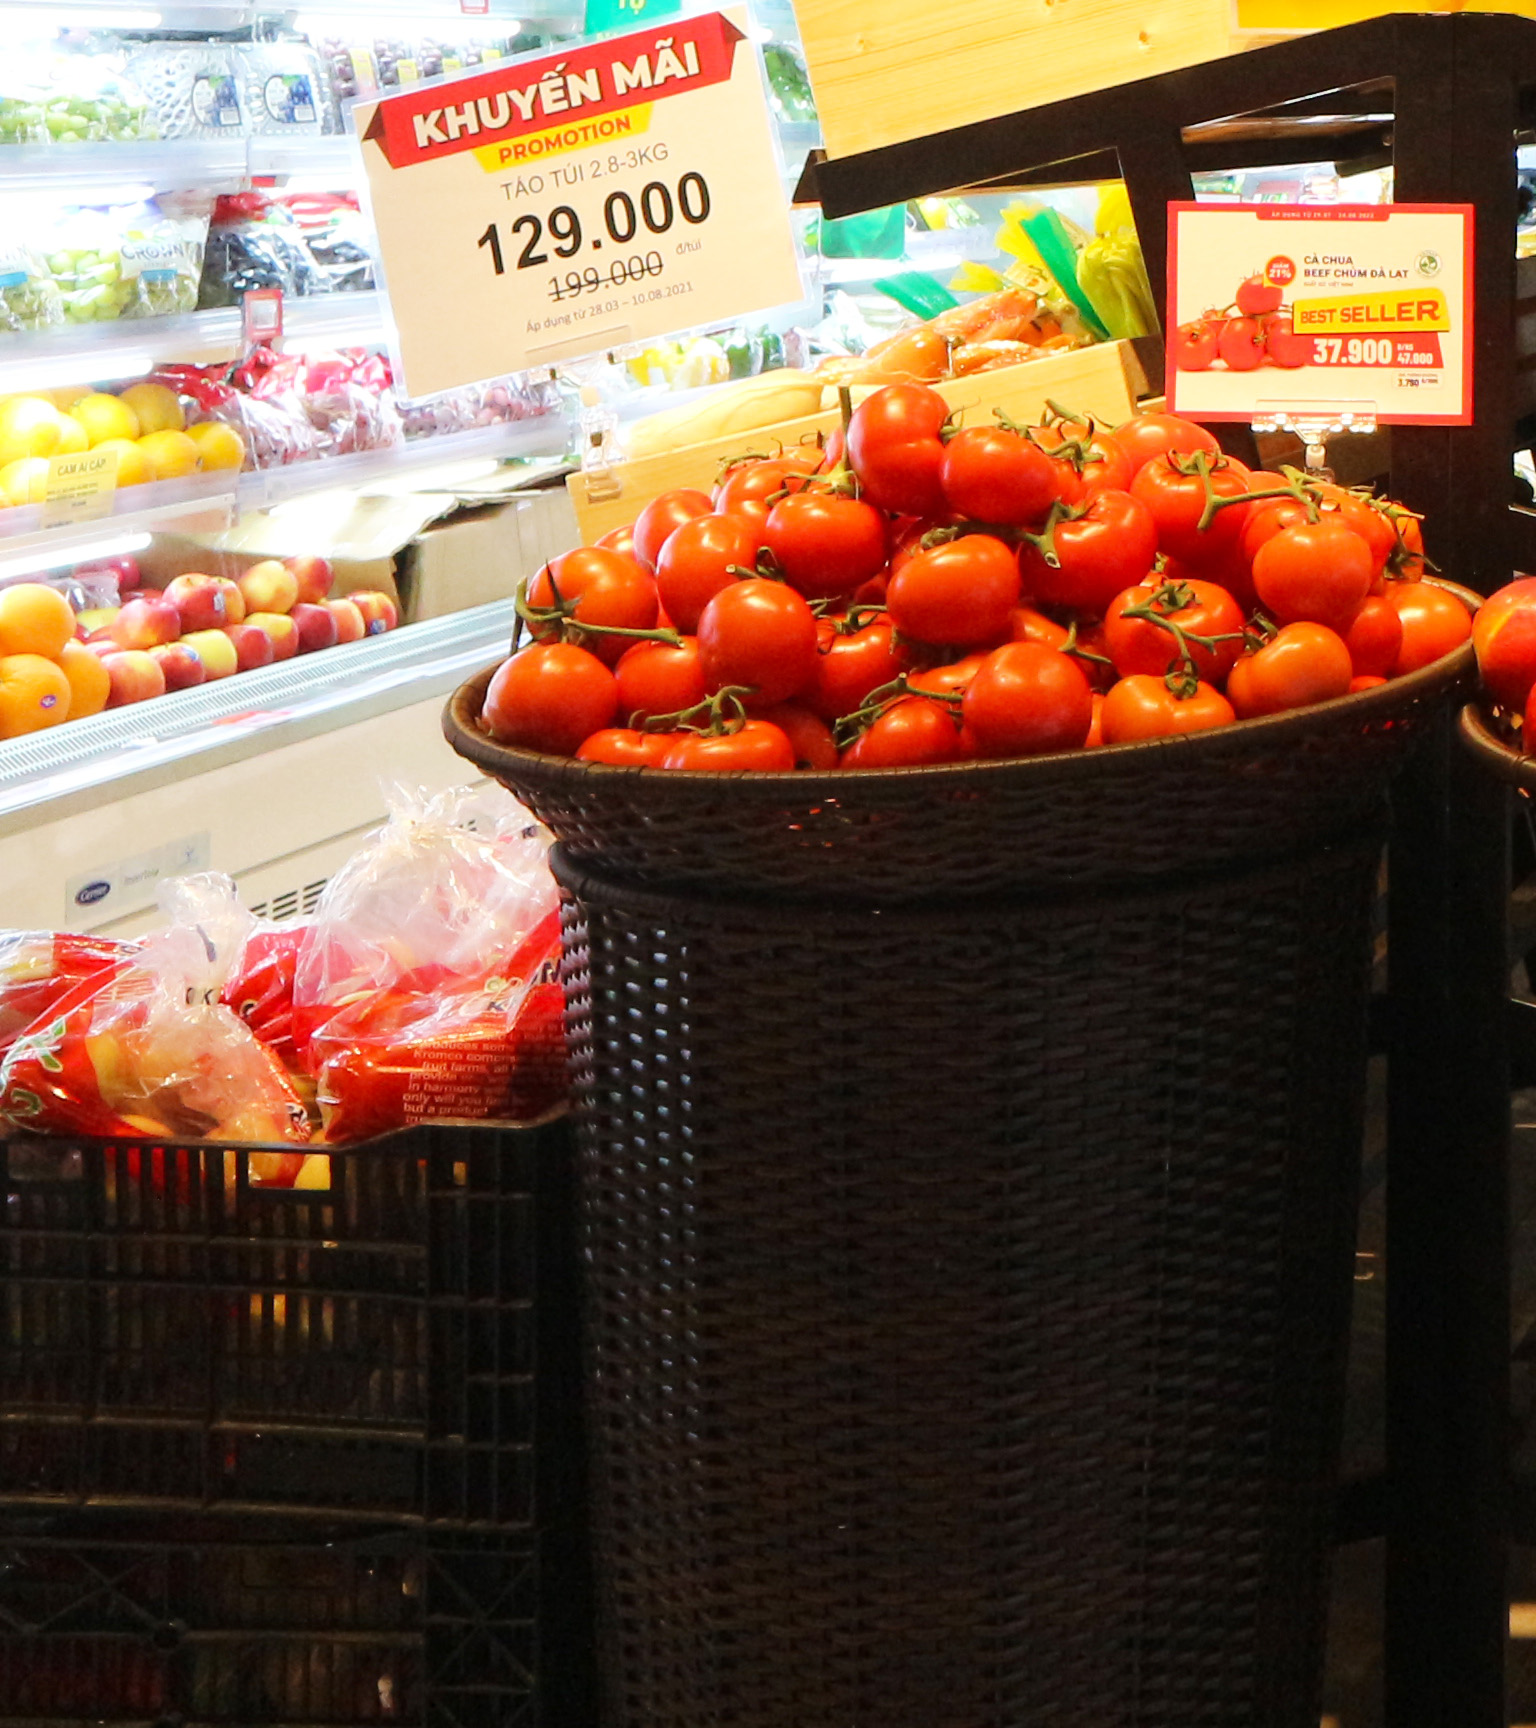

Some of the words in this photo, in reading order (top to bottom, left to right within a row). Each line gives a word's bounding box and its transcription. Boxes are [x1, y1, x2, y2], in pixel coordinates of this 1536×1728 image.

[411, 63, 602, 149] KHUYẾN
[611, 36, 701, 96] MÃI
[498, 115, 632, 164] PROMOTION
[501, 175, 545, 202] TÁO
[551, 162, 585, 190] TÚI
[591, 142, 670, 180] 2.8-3KG
[476, 171, 711, 276] 129.000
[548, 250, 665, 303] 199.000
[1268, 268, 1293, 280] 21%
[1303, 254, 1319, 266] CÀ
[1321, 255, 1353, 266] CHUA
[1303, 268, 1331, 279] BEEF
[1333, 266, 1368, 279] CHÙM
[1370, 266, 1387, 279] ĐÀ
[1388, 268, 1409, 281] LẠT
[525, 319, 542, 334] Áp
[544, 312, 572, 332] dụng
[573, 306, 588, 323] từ
[588, 298, 621, 317] 28.03
[631, 280, 695, 308] 10.08.2021
[1300, 306, 1338, 325] BEST
[1339, 299, 1441, 323] SELLER
[1313, 337, 1393, 366] 37.900
[1396, 352, 1434, 366] 47.000
